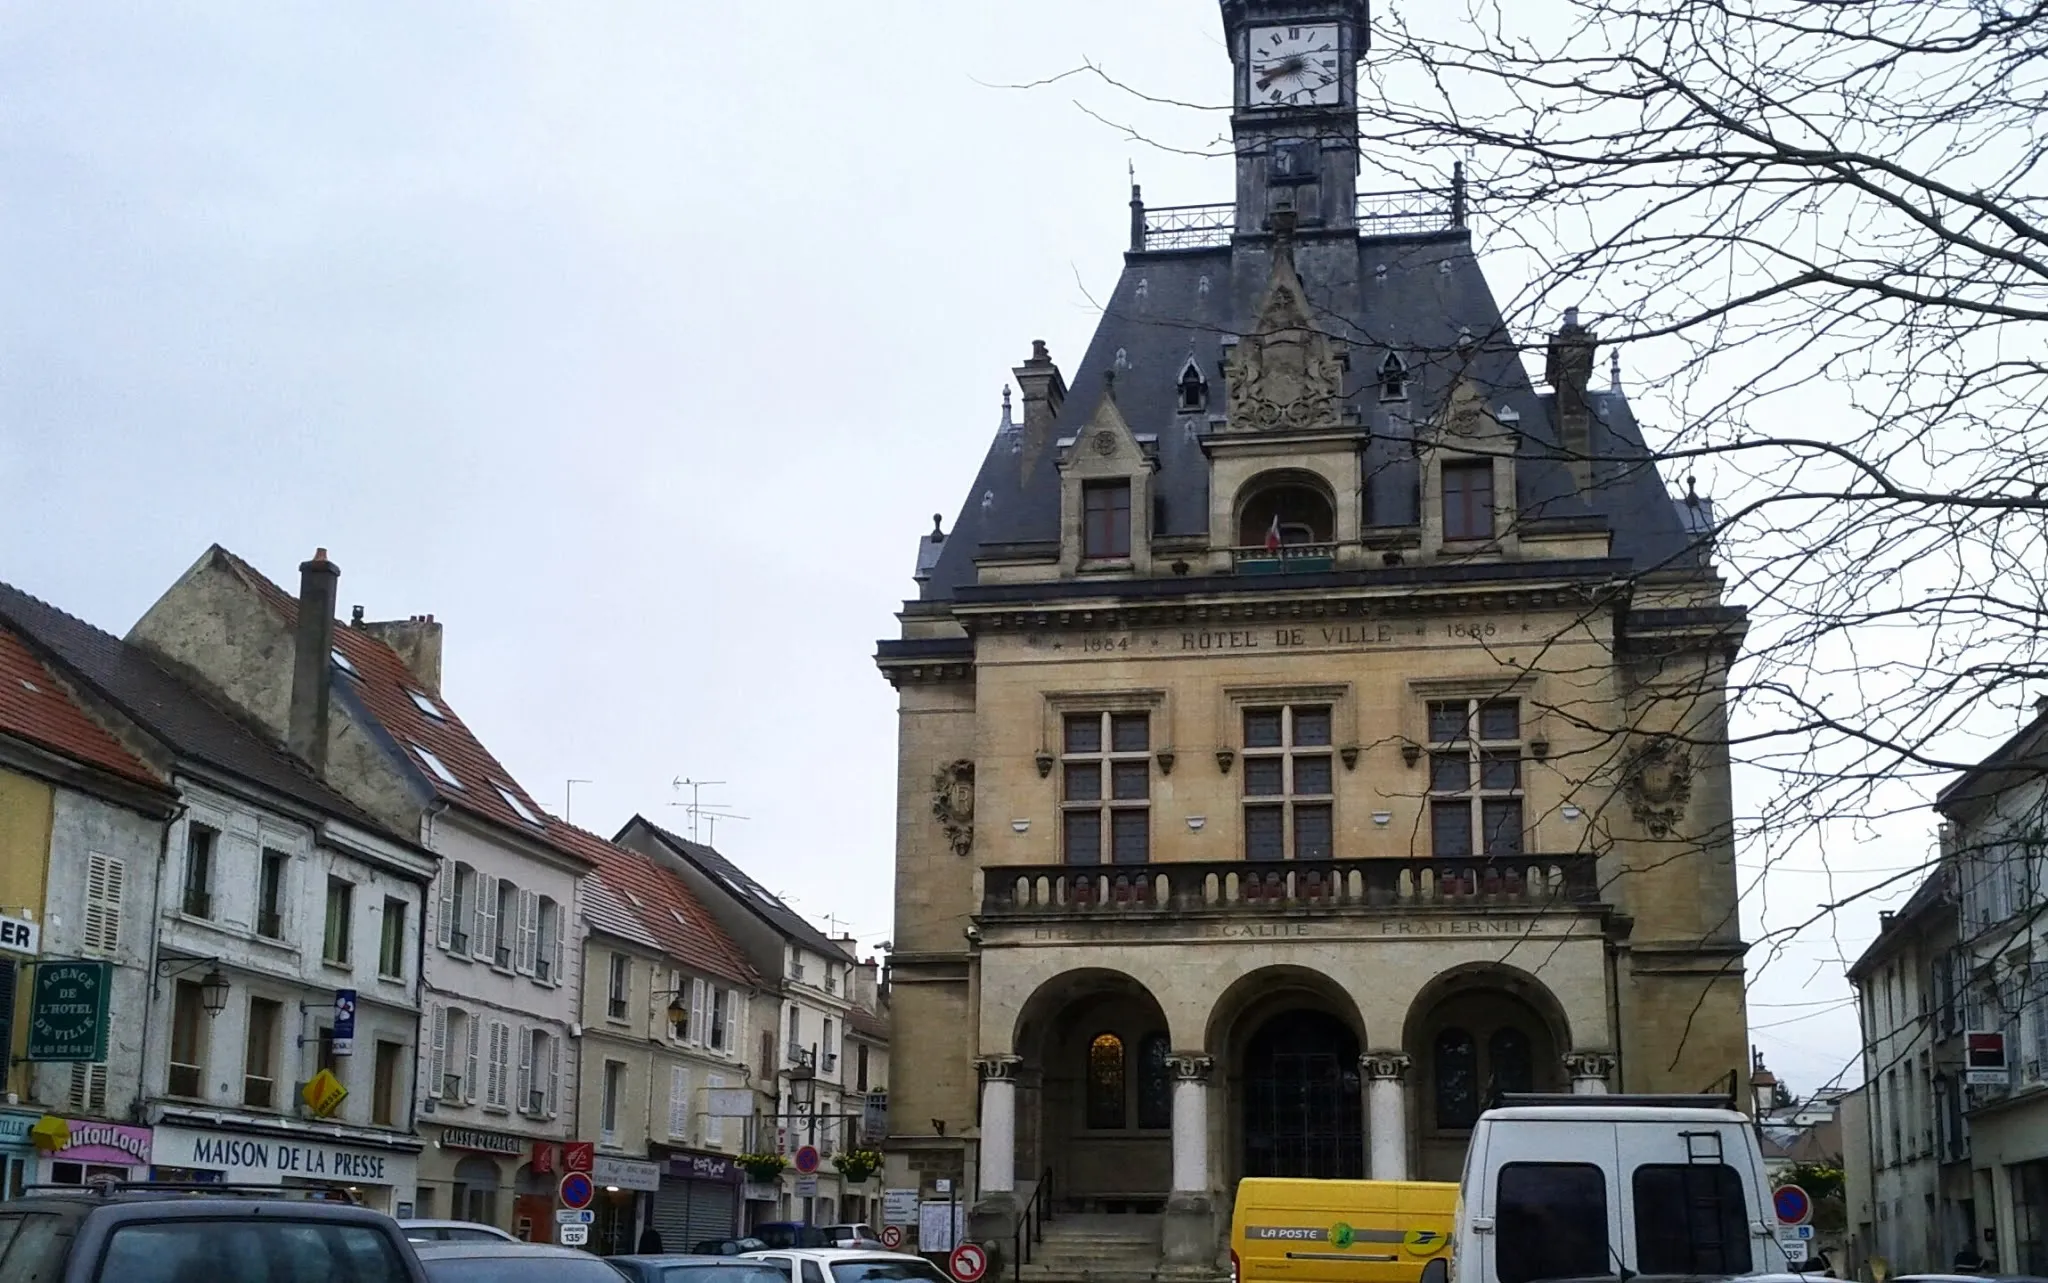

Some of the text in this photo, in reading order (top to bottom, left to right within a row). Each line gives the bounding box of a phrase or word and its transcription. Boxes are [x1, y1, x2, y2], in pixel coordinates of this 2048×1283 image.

[1083, 637, 1130, 652] 1884
[1275, 629, 1304, 646] DE
[1322, 625, 1392, 644] VILLE
[43, 967, 95, 989] AGENCE
[59, 988, 77, 998] DE
[34, 1016, 95, 1040] DE VILLE
[443, 1128, 477, 1148] CAISSE
[193, 1136, 385, 1179] MAISON DE LA PRESSE
[1260, 1228, 1318, 1239] LA POSTE
